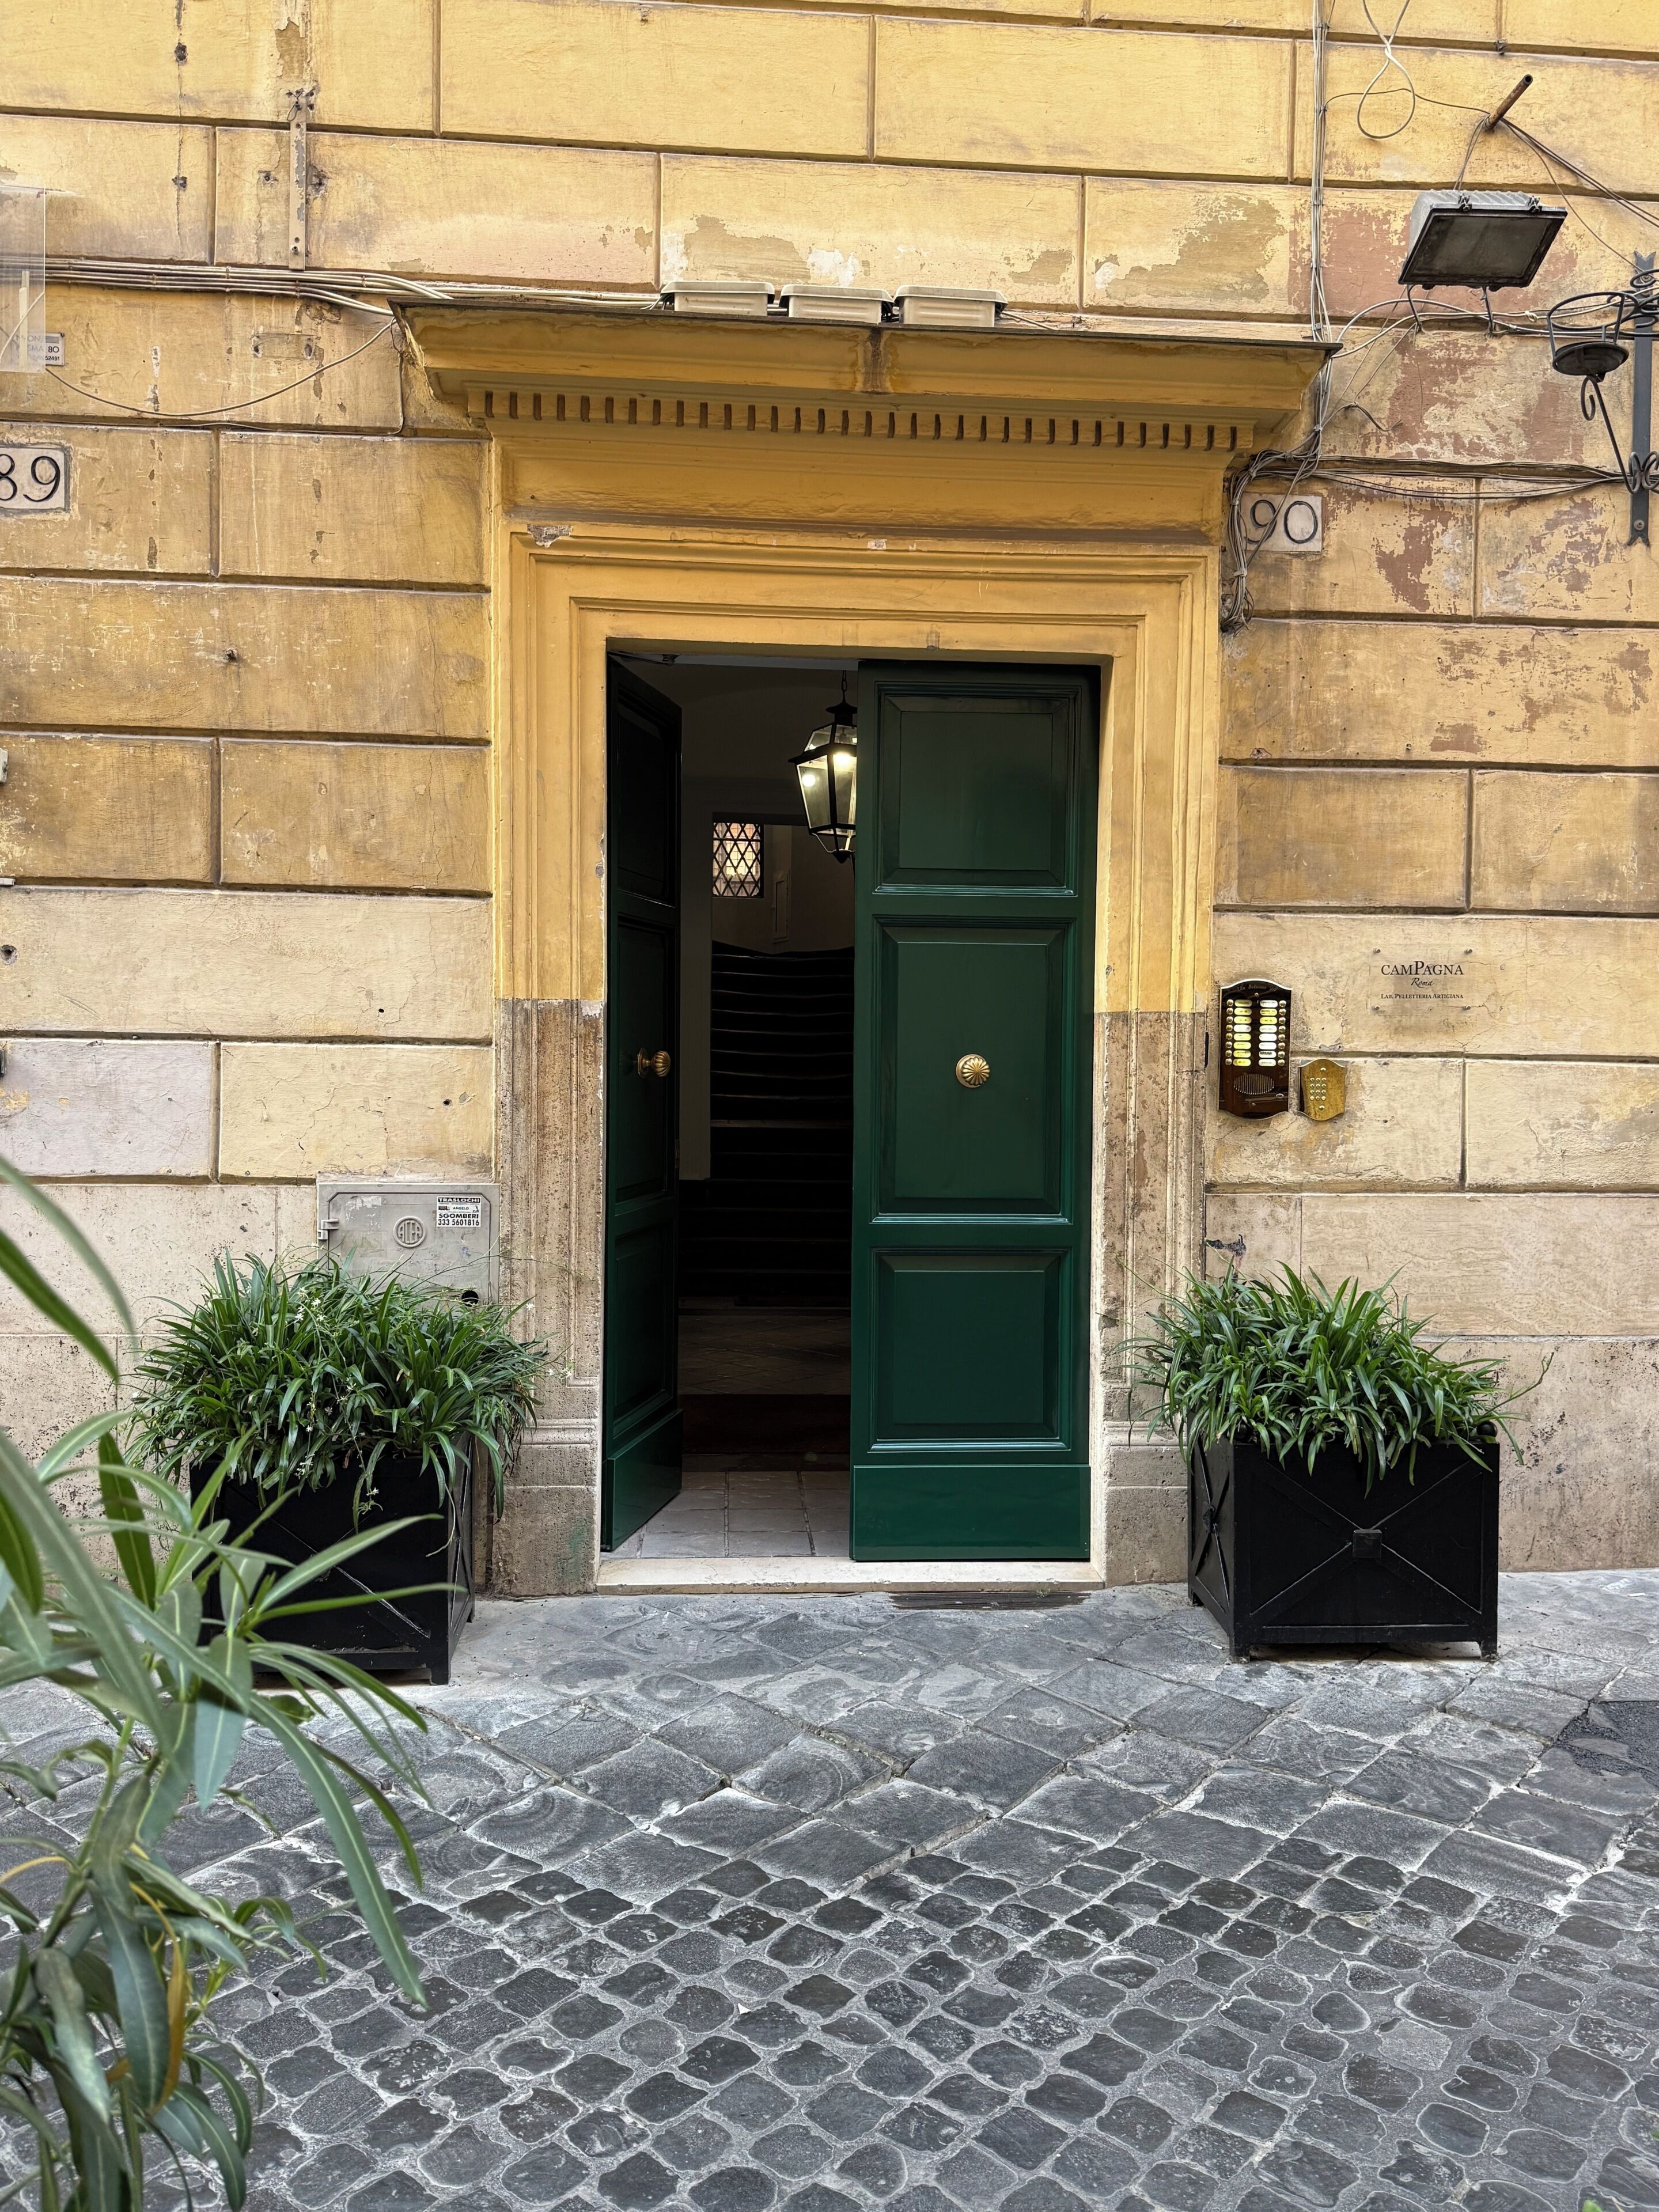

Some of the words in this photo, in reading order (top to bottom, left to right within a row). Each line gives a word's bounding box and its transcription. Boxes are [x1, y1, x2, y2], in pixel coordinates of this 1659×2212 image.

[0, 454, 60, 502] 89
[1244, 499, 1318, 544] 90
[1381, 960, 1464, 975] CAMPAGNA
[1410, 978, 1434, 988] Roma
